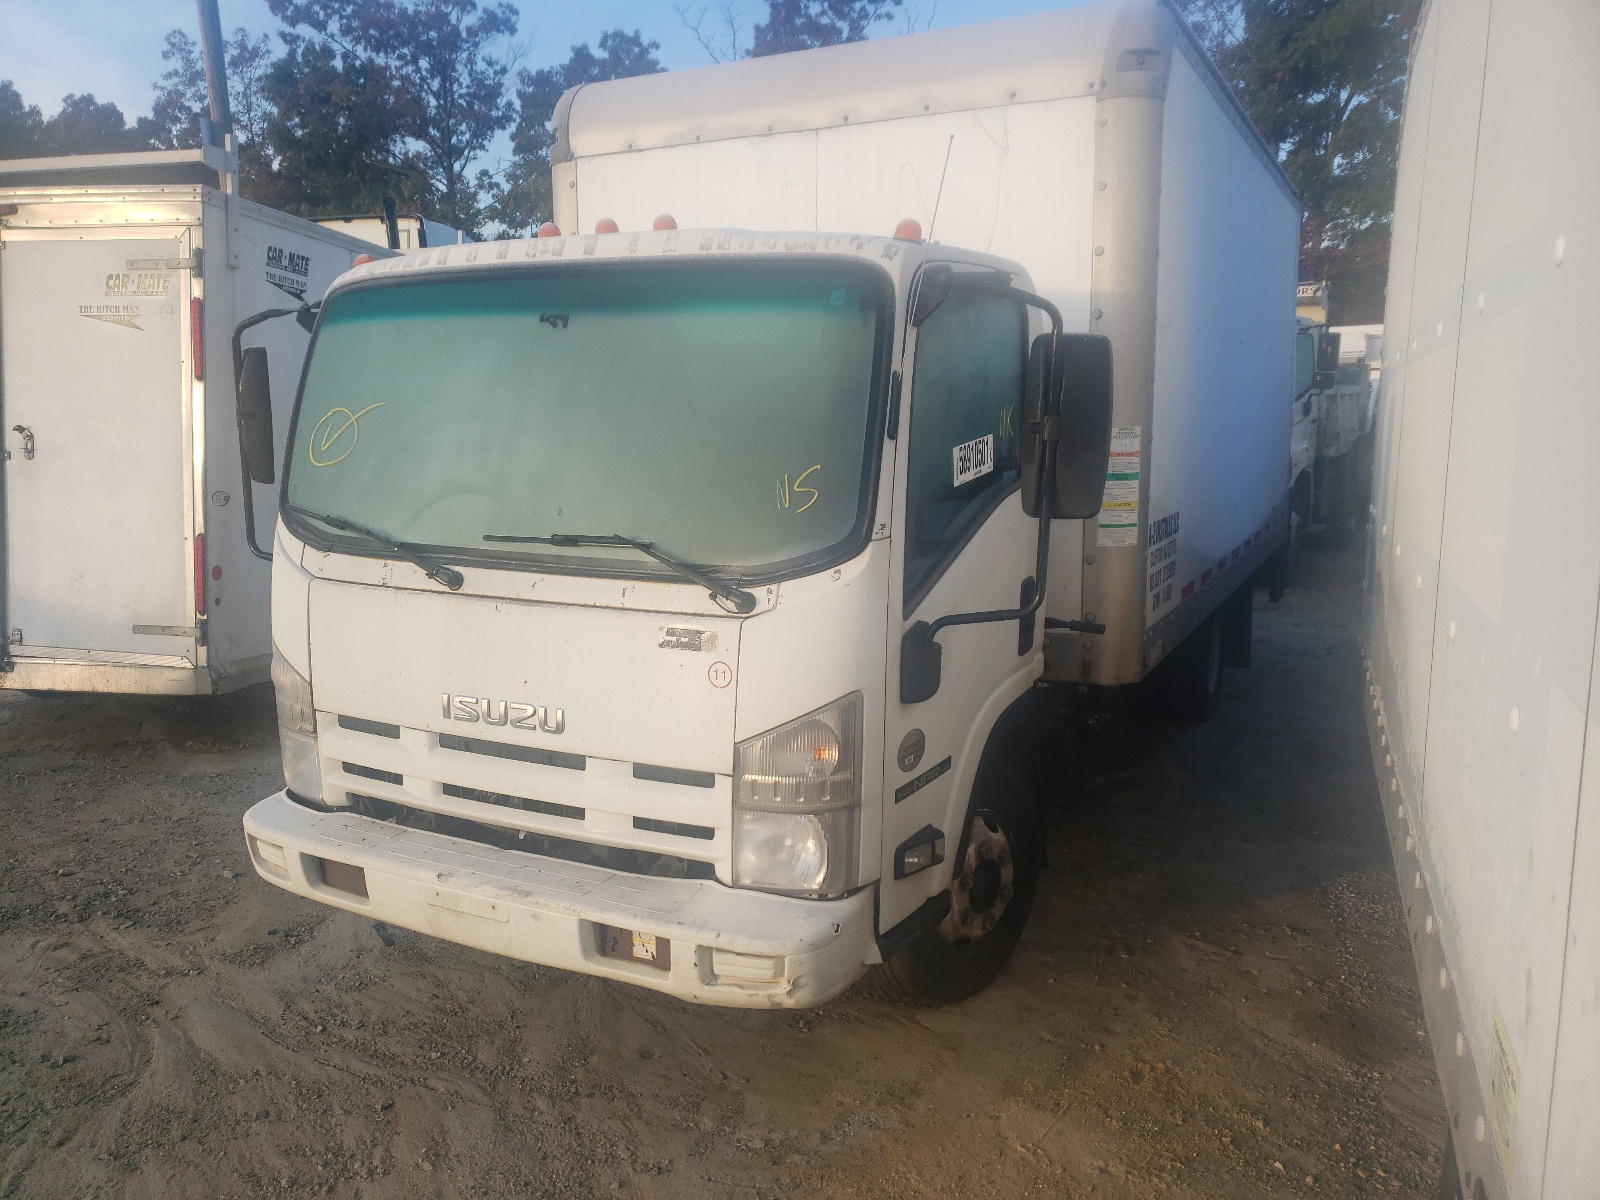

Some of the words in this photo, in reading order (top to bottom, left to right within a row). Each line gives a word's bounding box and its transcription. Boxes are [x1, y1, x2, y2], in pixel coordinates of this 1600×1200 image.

[266, 246, 283, 265] CAR
[288, 251, 310, 272] MATE
[105, 273, 129, 291] CAR
[136, 273, 170, 291] MATE
[79, 305, 95, 314] THE
[96, 305, 120, 314] HITCH
[122, 305, 140, 314] MAN
[959, 436, 989, 476] 58910501
[713, 668, 726, 681] 11
[441, 693, 565, 735] ISUZU
